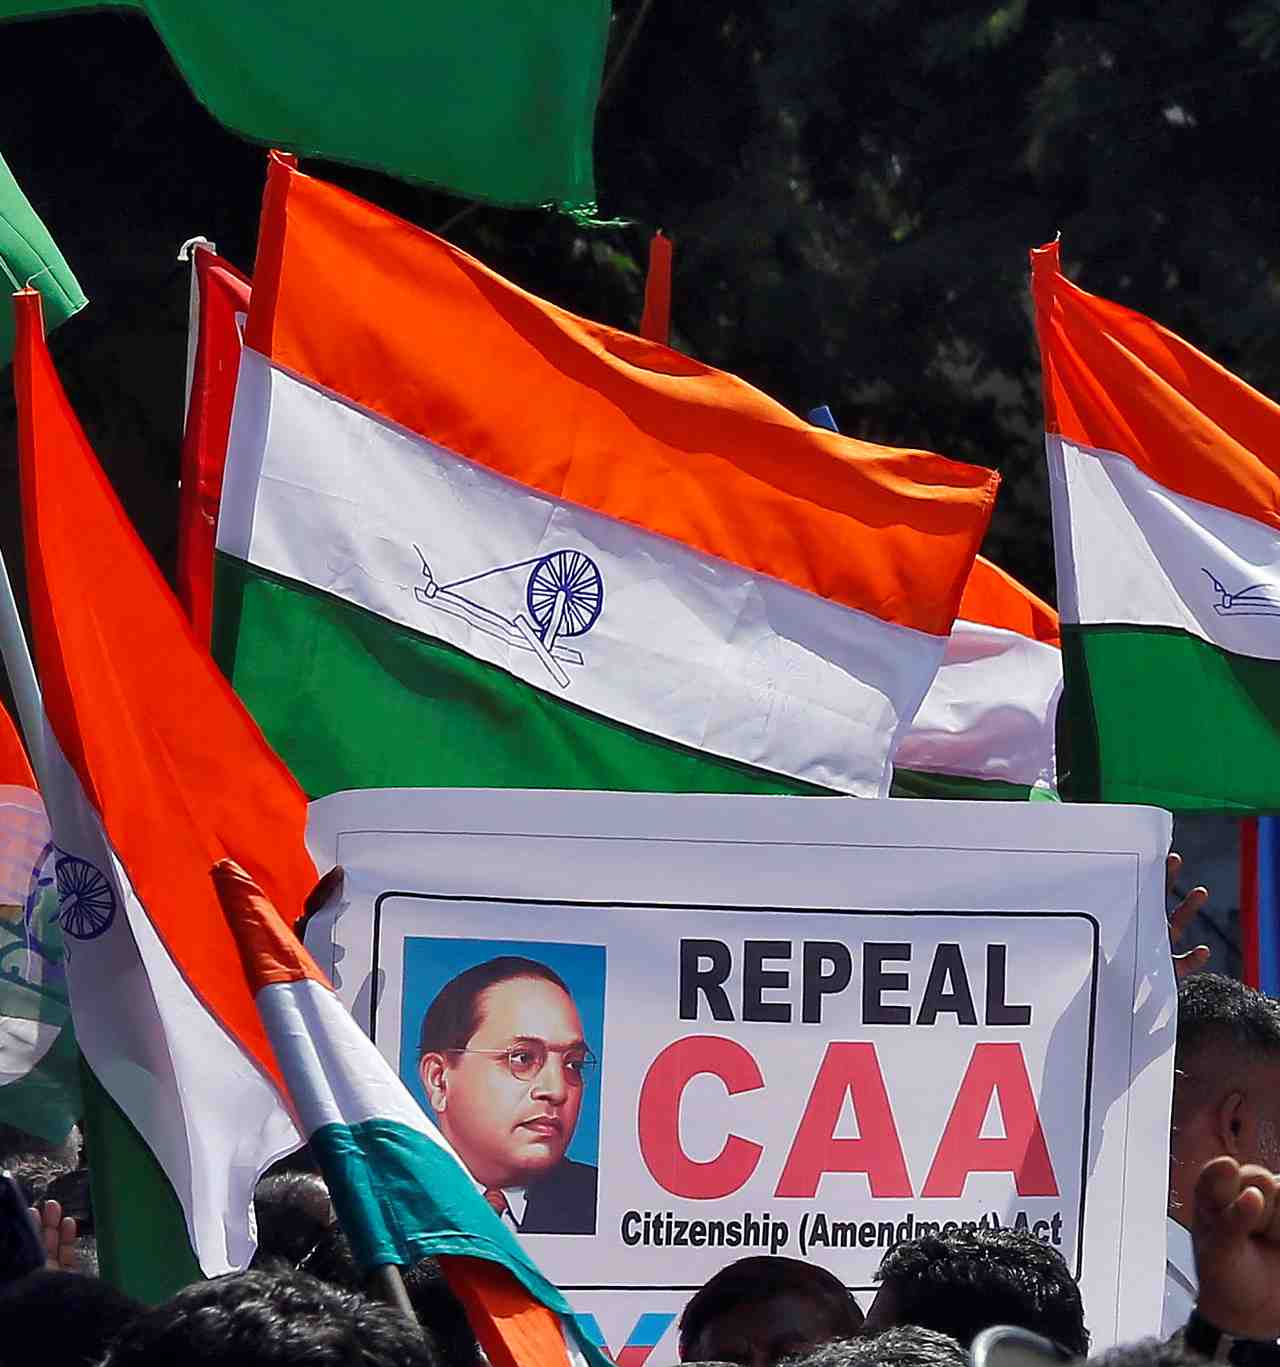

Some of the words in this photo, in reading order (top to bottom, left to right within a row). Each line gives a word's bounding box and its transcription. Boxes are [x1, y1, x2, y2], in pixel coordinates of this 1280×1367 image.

[680, 939, 1032, 1026] REPEAL
[639, 1036, 1058, 1200] CAA
[621, 1211, 789, 1255] Citizenship
[1014, 1211, 1063, 1246] Act
